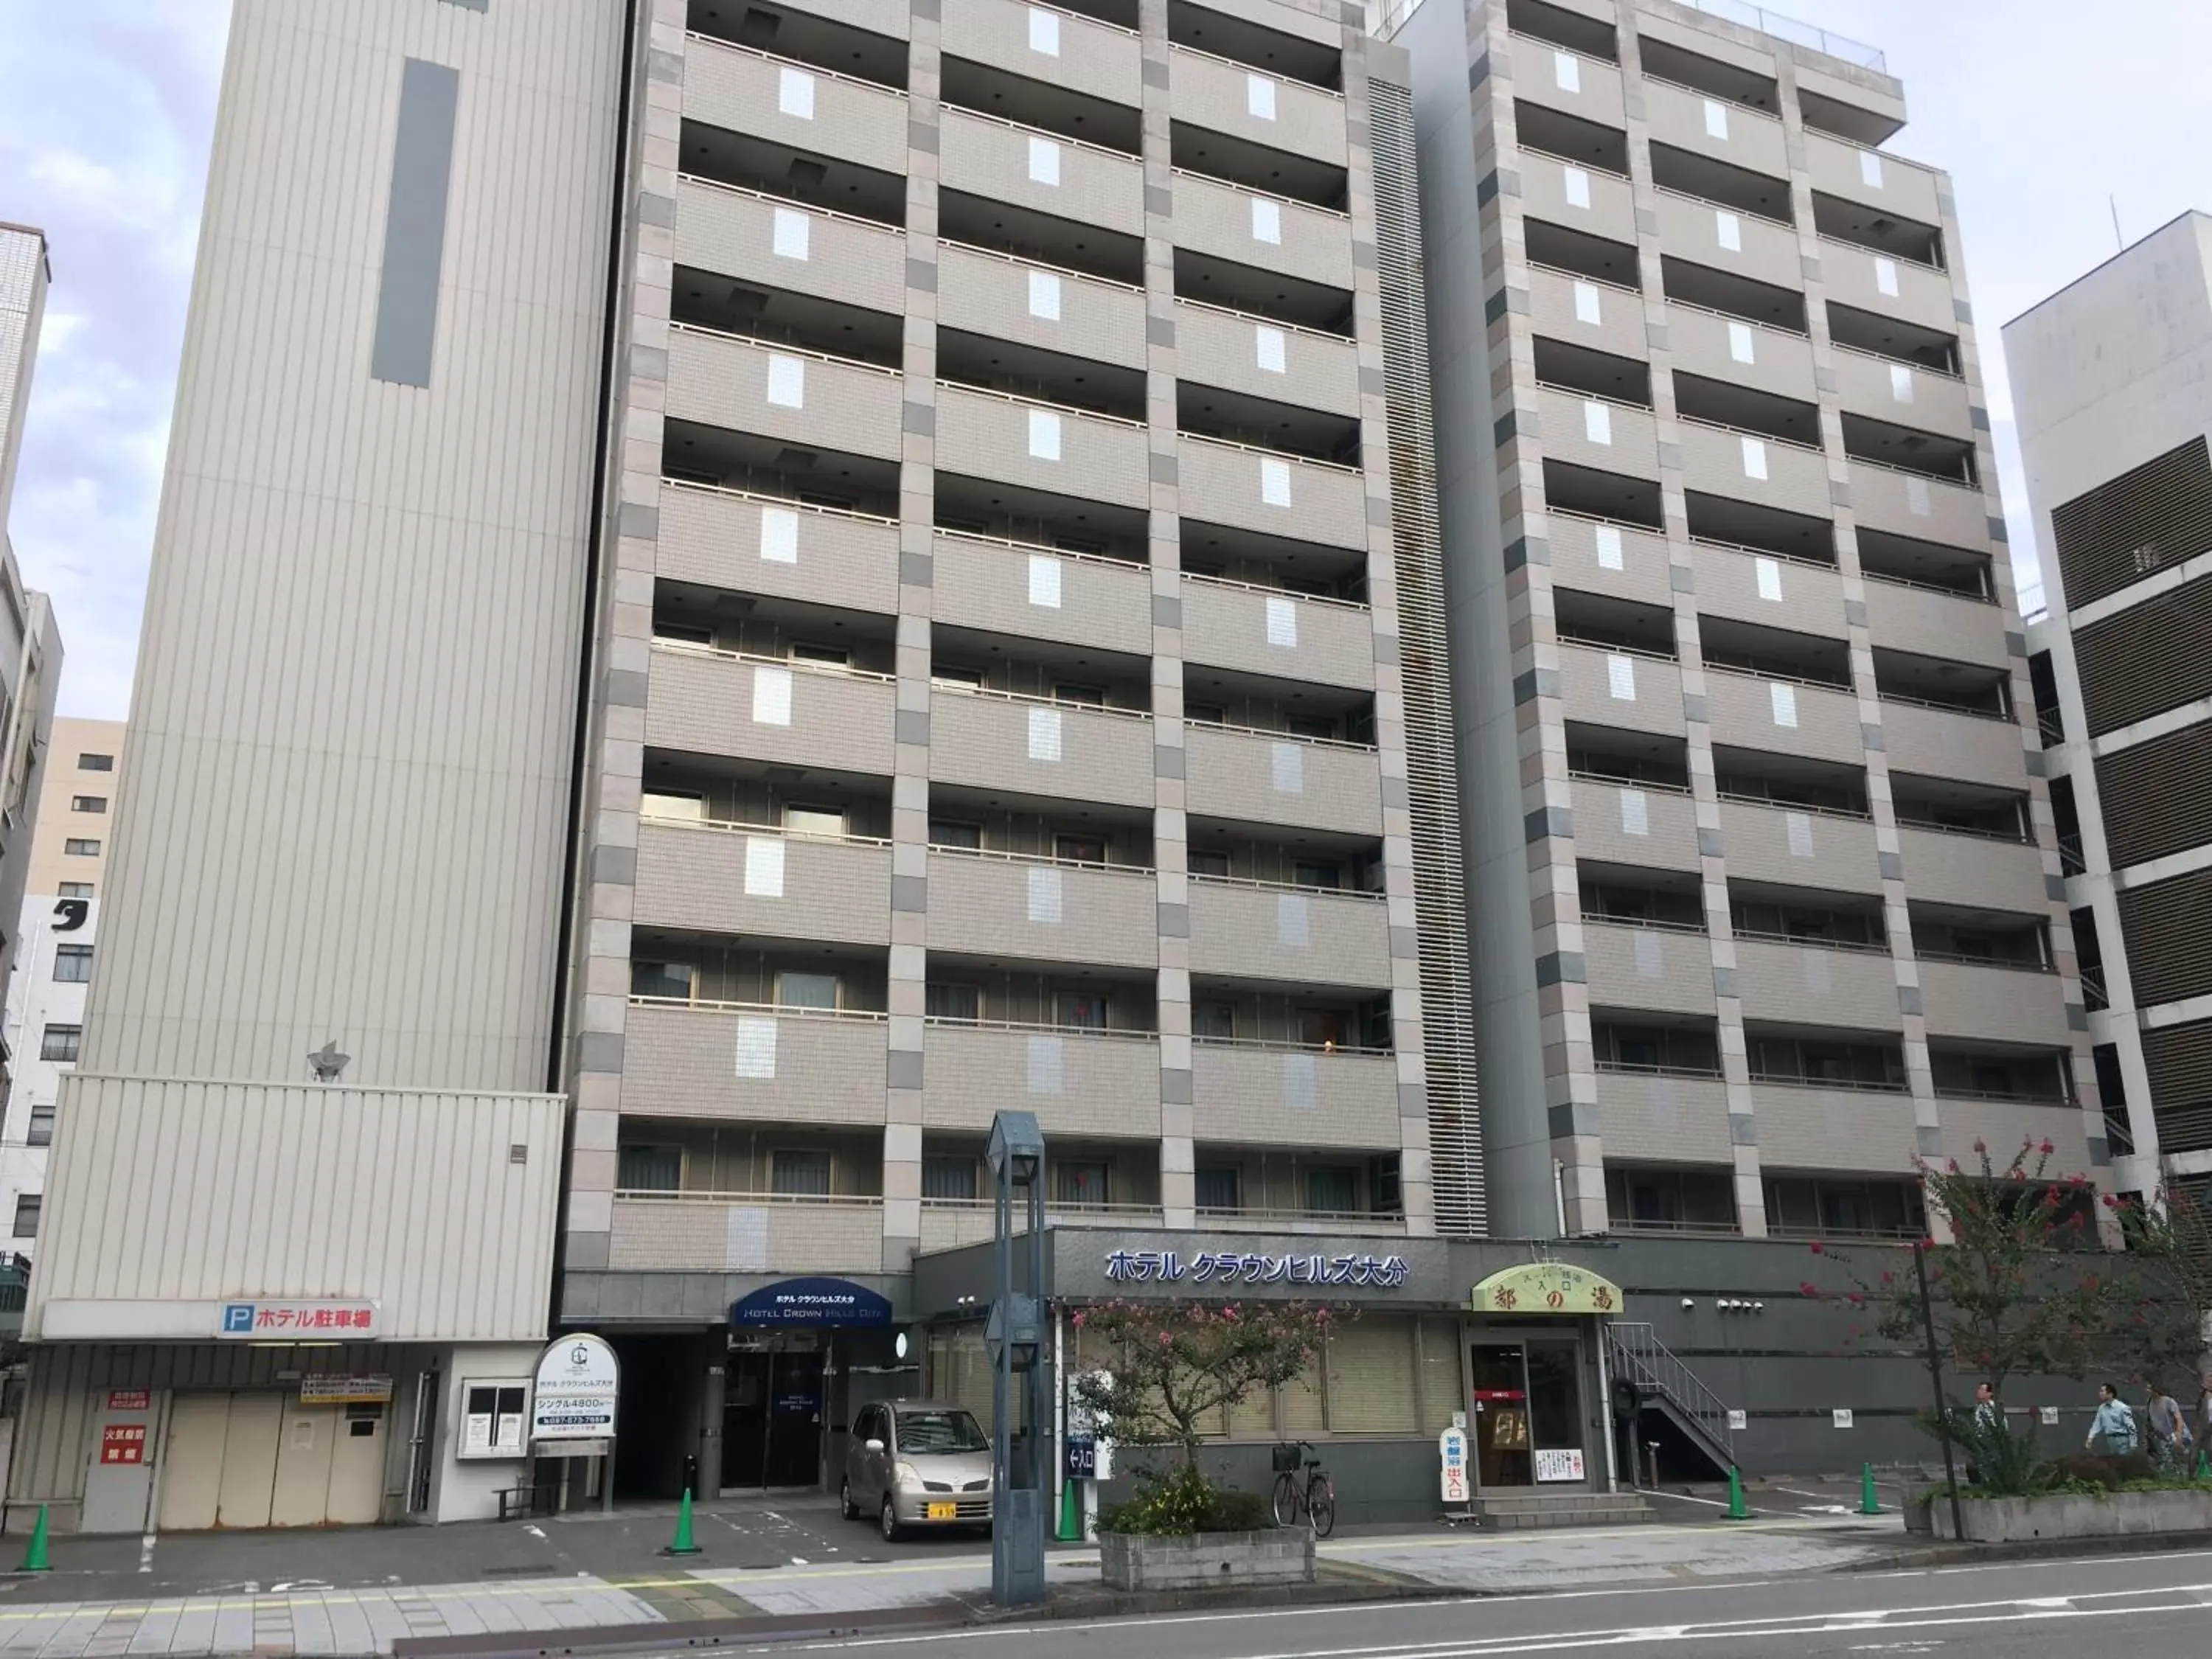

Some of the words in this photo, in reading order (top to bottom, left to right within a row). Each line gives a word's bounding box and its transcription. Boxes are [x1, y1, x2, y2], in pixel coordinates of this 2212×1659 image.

[1107, 1251, 1184, 1281] ホテル
[1192, 1255, 1410, 1287] クラウンヒルズ大分
[776, 1295, 796, 1304] ホテル
[797, 1295, 855, 1304] クラウンヒルズ大分
[257, 1309, 372, 1329] ホテル駐車場
[744, 1309, 782, 1318] HOTEL
[784, 1309, 822, 1318] CROWN
